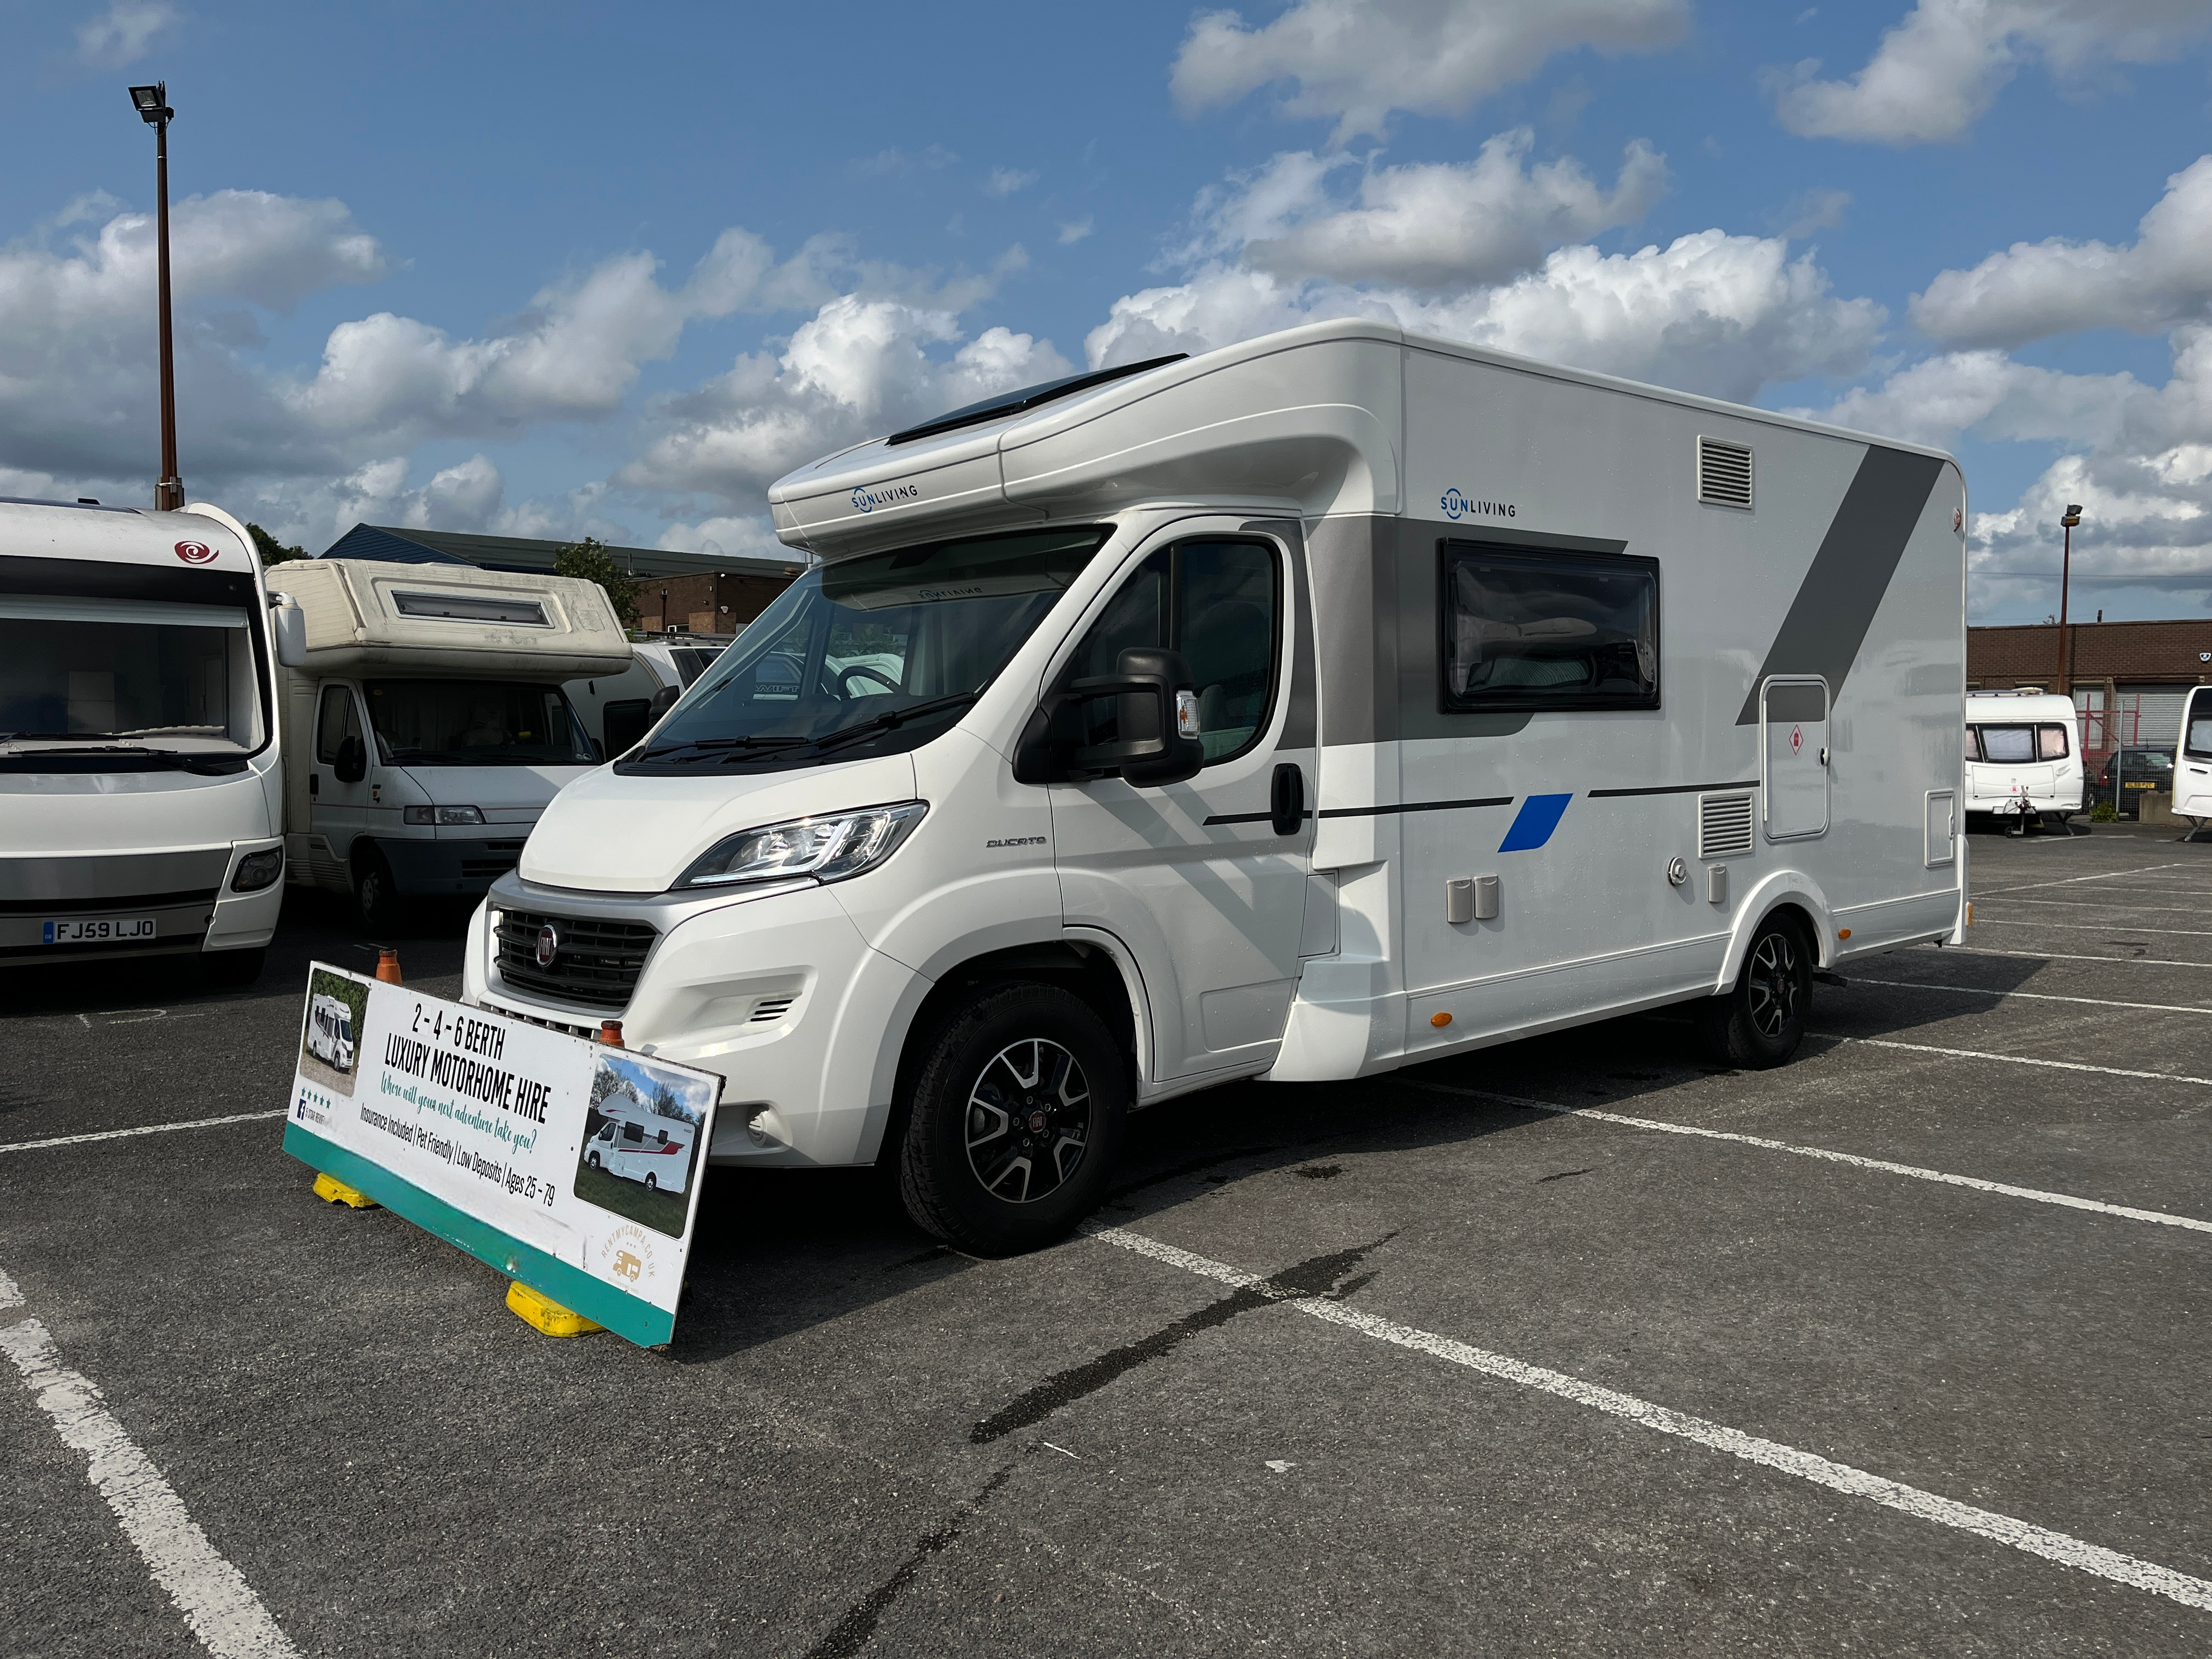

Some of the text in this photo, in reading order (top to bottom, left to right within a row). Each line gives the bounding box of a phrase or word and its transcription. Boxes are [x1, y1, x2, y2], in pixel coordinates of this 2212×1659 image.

[851, 484, 918, 510] SUNLIVING
[1441, 495, 1515, 517] SUNLIVING
[986, 836, 1046, 848] DUCATO
[57, 922, 110, 940] FJ59
[539, 936, 552, 956] FIAT
[412, 1003, 421, 1032] 2
[433, 1010, 443, 1040] 4
[454, 1016, 464, 1047] 6
[464, 1019, 506, 1060] BERTH
[385, 1032, 551, 1124] LUXURY MOTORHOME HIRE
[381, 1071, 537, 1154] Where will your next adventure take you?
[1032, 1116, 1043, 1128] FIAT
[360, 1102, 388, 1131] Insurance
[387, 1115, 414, 1144] Included
[416, 1127, 428, 1150] Pet
[427, 1132, 454, 1165] Friendly
[457, 1144, 472, 1169] Low
[472, 1152, 502, 1183] Deposits
[505, 1167, 525, 1195] Ages
[524, 1175, 537, 1200] 25
[543, 1182, 555, 1207] 79
[601, 1224, 655, 1278] RENTMYCAMPA.CO.UK
